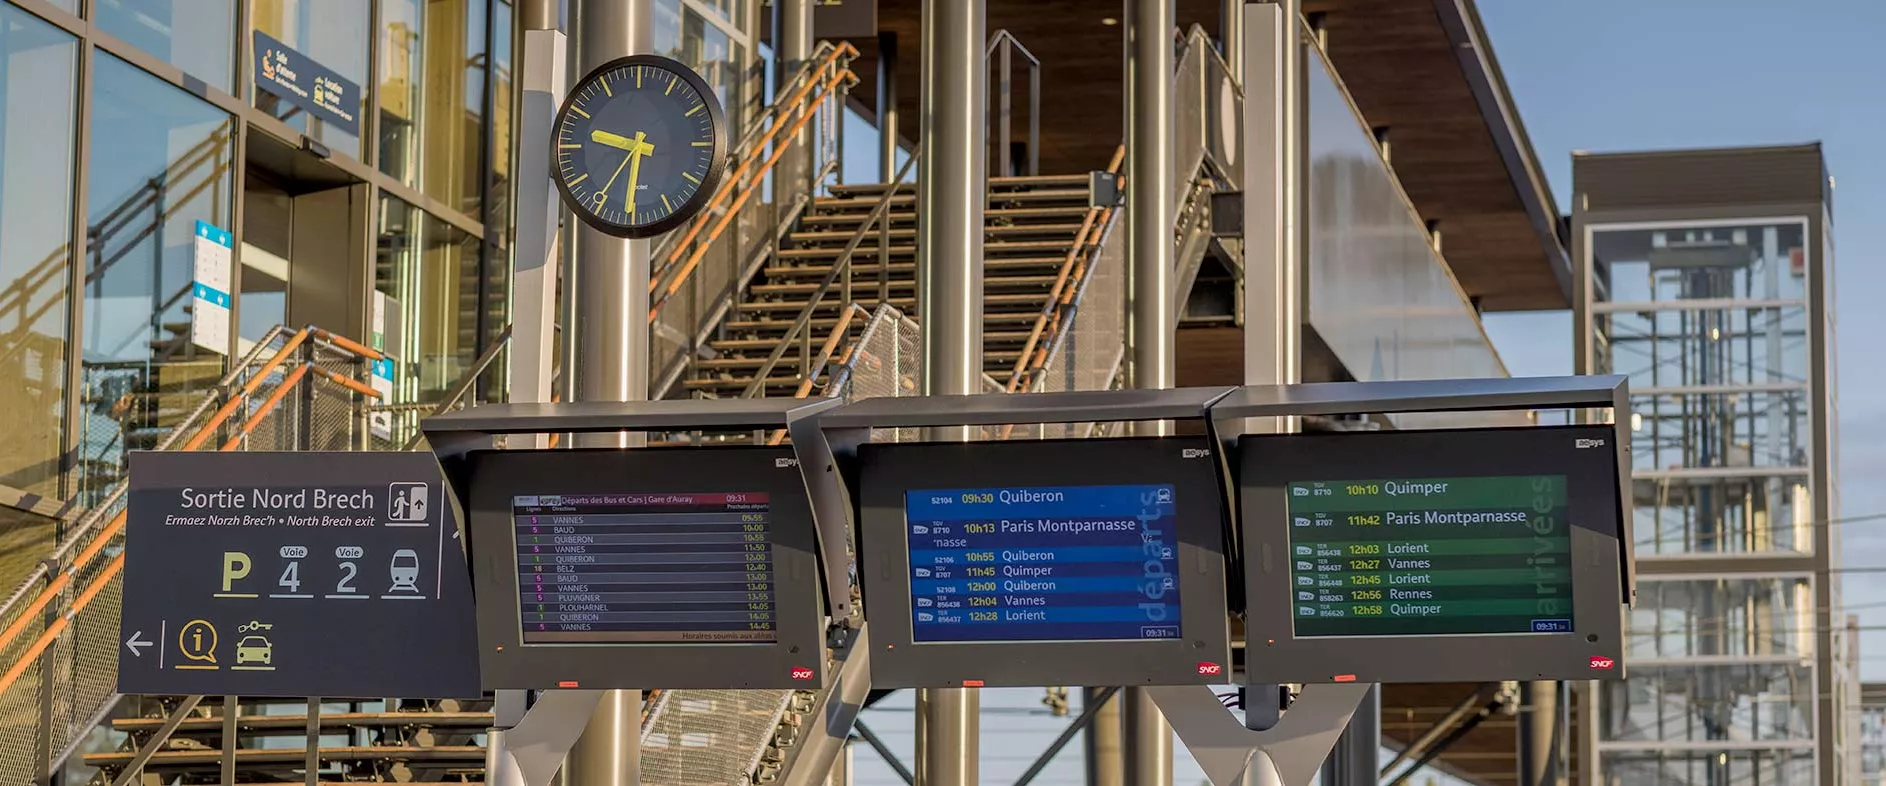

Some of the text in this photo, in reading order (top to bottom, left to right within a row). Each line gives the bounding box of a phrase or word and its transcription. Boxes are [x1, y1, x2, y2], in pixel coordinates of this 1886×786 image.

[1346, 485, 1379, 495] 10h10
[1385, 481, 1448, 496] Quimper
[181, 488, 374, 509] Sortie Nord Brech
[562, 496, 590, 505] Départs
[667, 495, 693, 504] d'Auray
[962, 494, 993, 503] 09h30
[999, 490, 1064, 502] Quiberon
[166, 516, 206, 526] Ermaez
[208, 516, 240, 526] Norzh
[287, 516, 375, 527] North Brech exit
[1348, 516, 1380, 525] 11h42
[1386, 512, 1420, 524] Paris
[1424, 510, 1526, 524] Montparnasse
[964, 524, 995, 533] 10h13
[1001, 520, 1034, 532] Paris
[1038, 518, 1136, 532] Montparnasse
[554, 536, 593, 544] QUIBERON
[1526, 476, 1557, 615] arrivées
[283, 548, 304, 557] Voie
[339, 548, 359, 558] Voie
[1349, 545, 1379, 554] 12h03
[1388, 543, 1429, 553] Lorient
[556, 555, 595, 563] QUIBERON
[965, 552, 994, 561] 10h55
[1003, 551, 1054, 562] Quiberon
[1137, 490, 1171, 621] départs
[1350, 560, 1380, 569] 12h27
[1388, 559, 1430, 569] Vannes
[222, 552, 251, 592] P
[279, 562, 300, 592] 4
[336, 562, 357, 592] 2
[966, 567, 995, 576] 11h45
[1003, 566, 1052, 578] Quimper
[1351, 575, 1381, 584] 12h45
[1389, 574, 1430, 584] Lorient
[968, 582, 996, 591] 12h00
[1004, 580, 1056, 592] Quiberon
[1351, 591, 1381, 600] 12h56
[1390, 589, 1432, 599] Rennes
[968, 597, 997, 606] 12h04
[1005, 596, 1045, 605] Vannes
[560, 603, 608, 612] PLOUHARNEL
[1352, 606, 1382, 615] 12h58
[1390, 604, 1441, 615] Quimper
[560, 613, 599, 621] QUIBERON
[969, 612, 998, 621] 12h28
[1006, 611, 1046, 620] Lorient
[561, 623, 591, 631] VANNES
